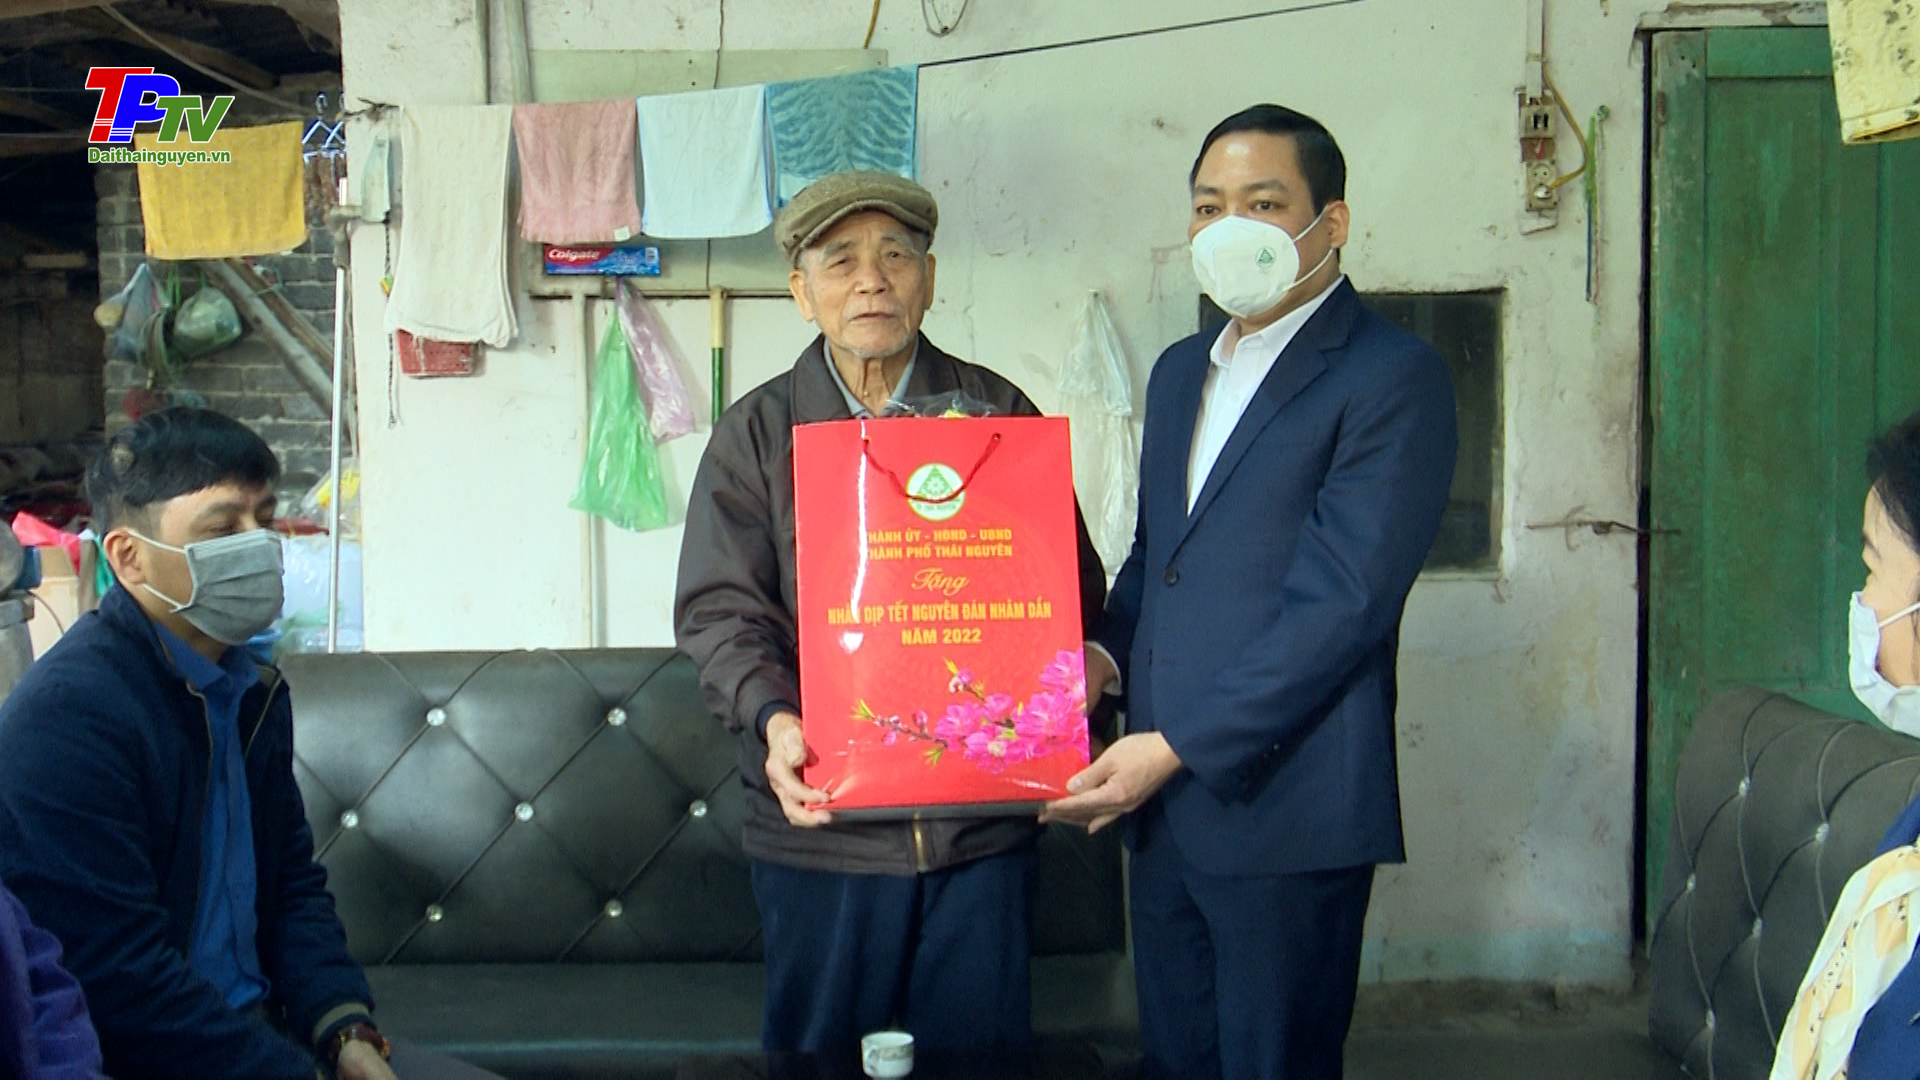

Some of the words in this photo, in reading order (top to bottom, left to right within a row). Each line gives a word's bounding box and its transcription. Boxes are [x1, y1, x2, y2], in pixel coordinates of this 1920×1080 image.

[548, 248, 601, 262] Colgate
[862, 528, 902, 543] HÀNH
[979, 528, 1013, 541] UBND
[862, 545, 903, 560] HÀNH
[906, 541, 932, 558] PHỐ
[935, 544, 963, 558] THÁI
[965, 543, 1013, 557] NGUYÊN
[911, 567, 970, 596] Tặng
[864, 605, 884, 627] DỊP
[887, 600, 909, 622] TẾT
[912, 599, 960, 621] NGUYÊN
[941, 627, 982, 644] 2022
